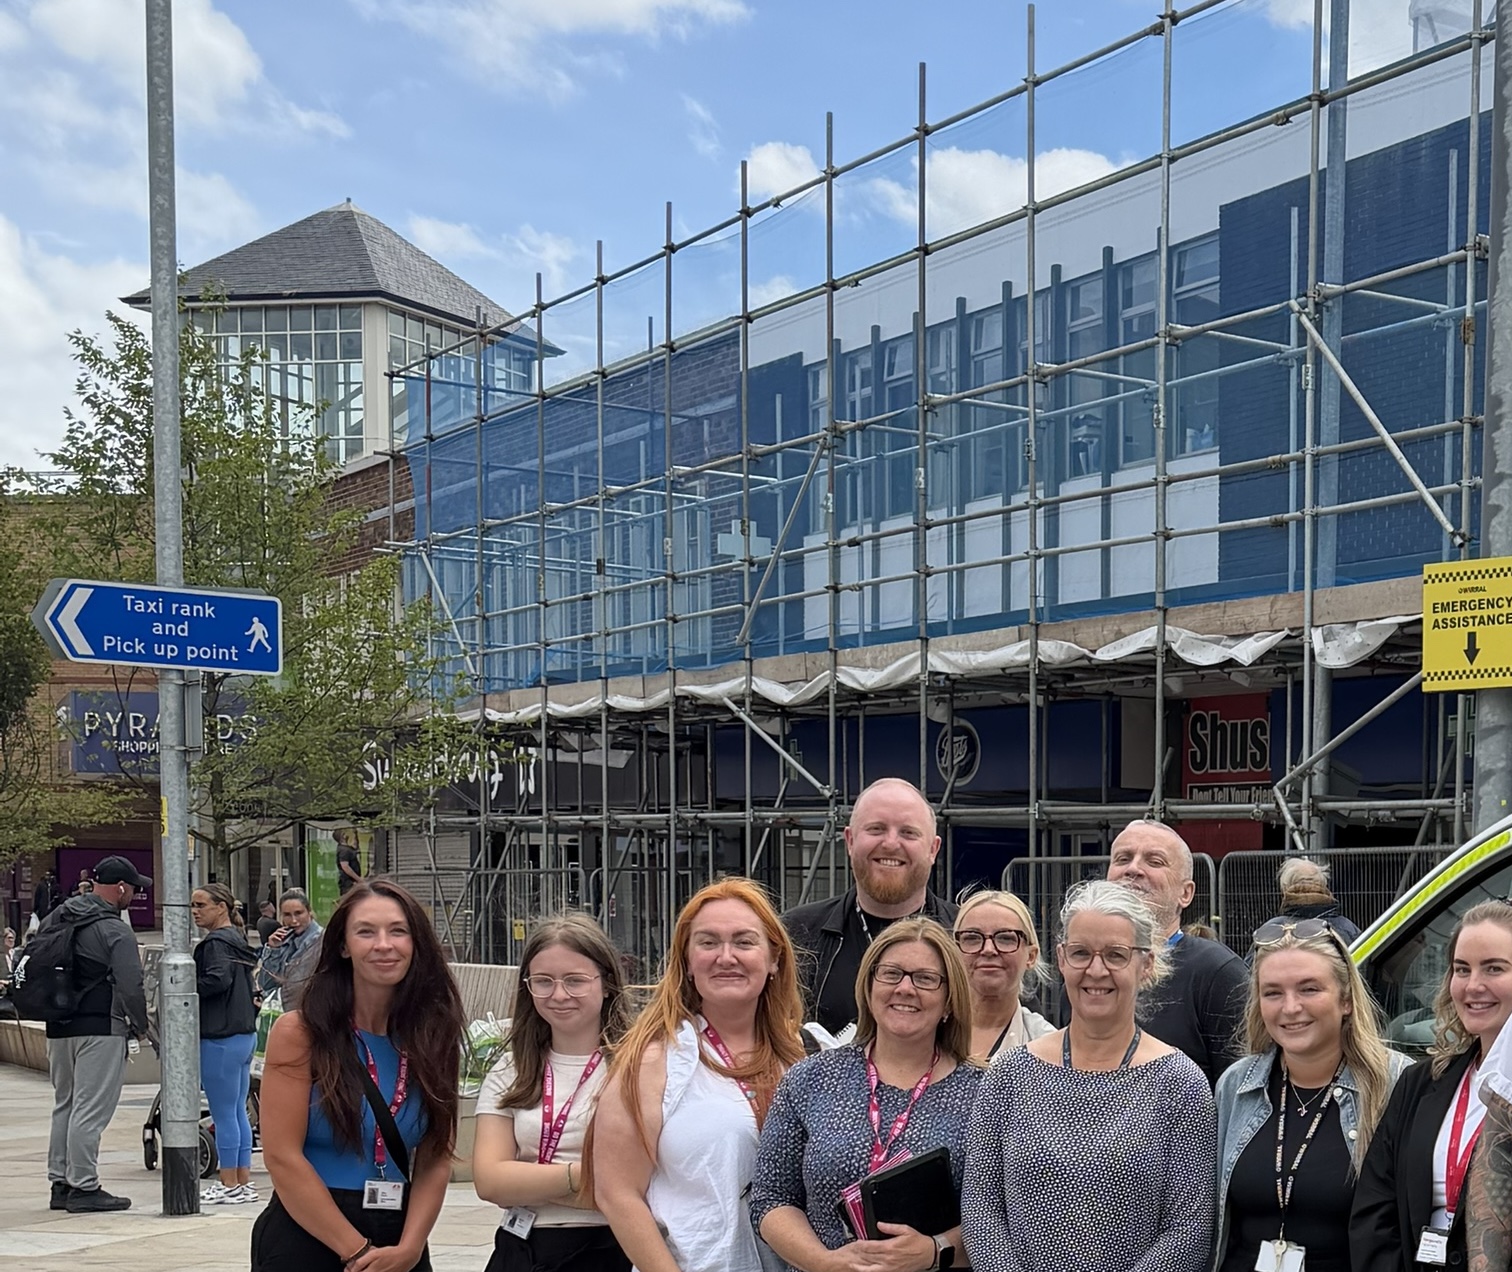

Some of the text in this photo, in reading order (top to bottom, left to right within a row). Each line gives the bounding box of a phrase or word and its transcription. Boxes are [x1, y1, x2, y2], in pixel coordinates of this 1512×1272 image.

[123, 595, 215, 618] Taxi rank
[152, 621, 189, 637] and
[103, 636, 239, 661] Pick up point
[1188, 710, 1272, 775] Shus
[1213, 786, 1229, 802] Tell
[1230, 786, 1250, 803] Your
[1251, 785, 1276, 803] Frien
